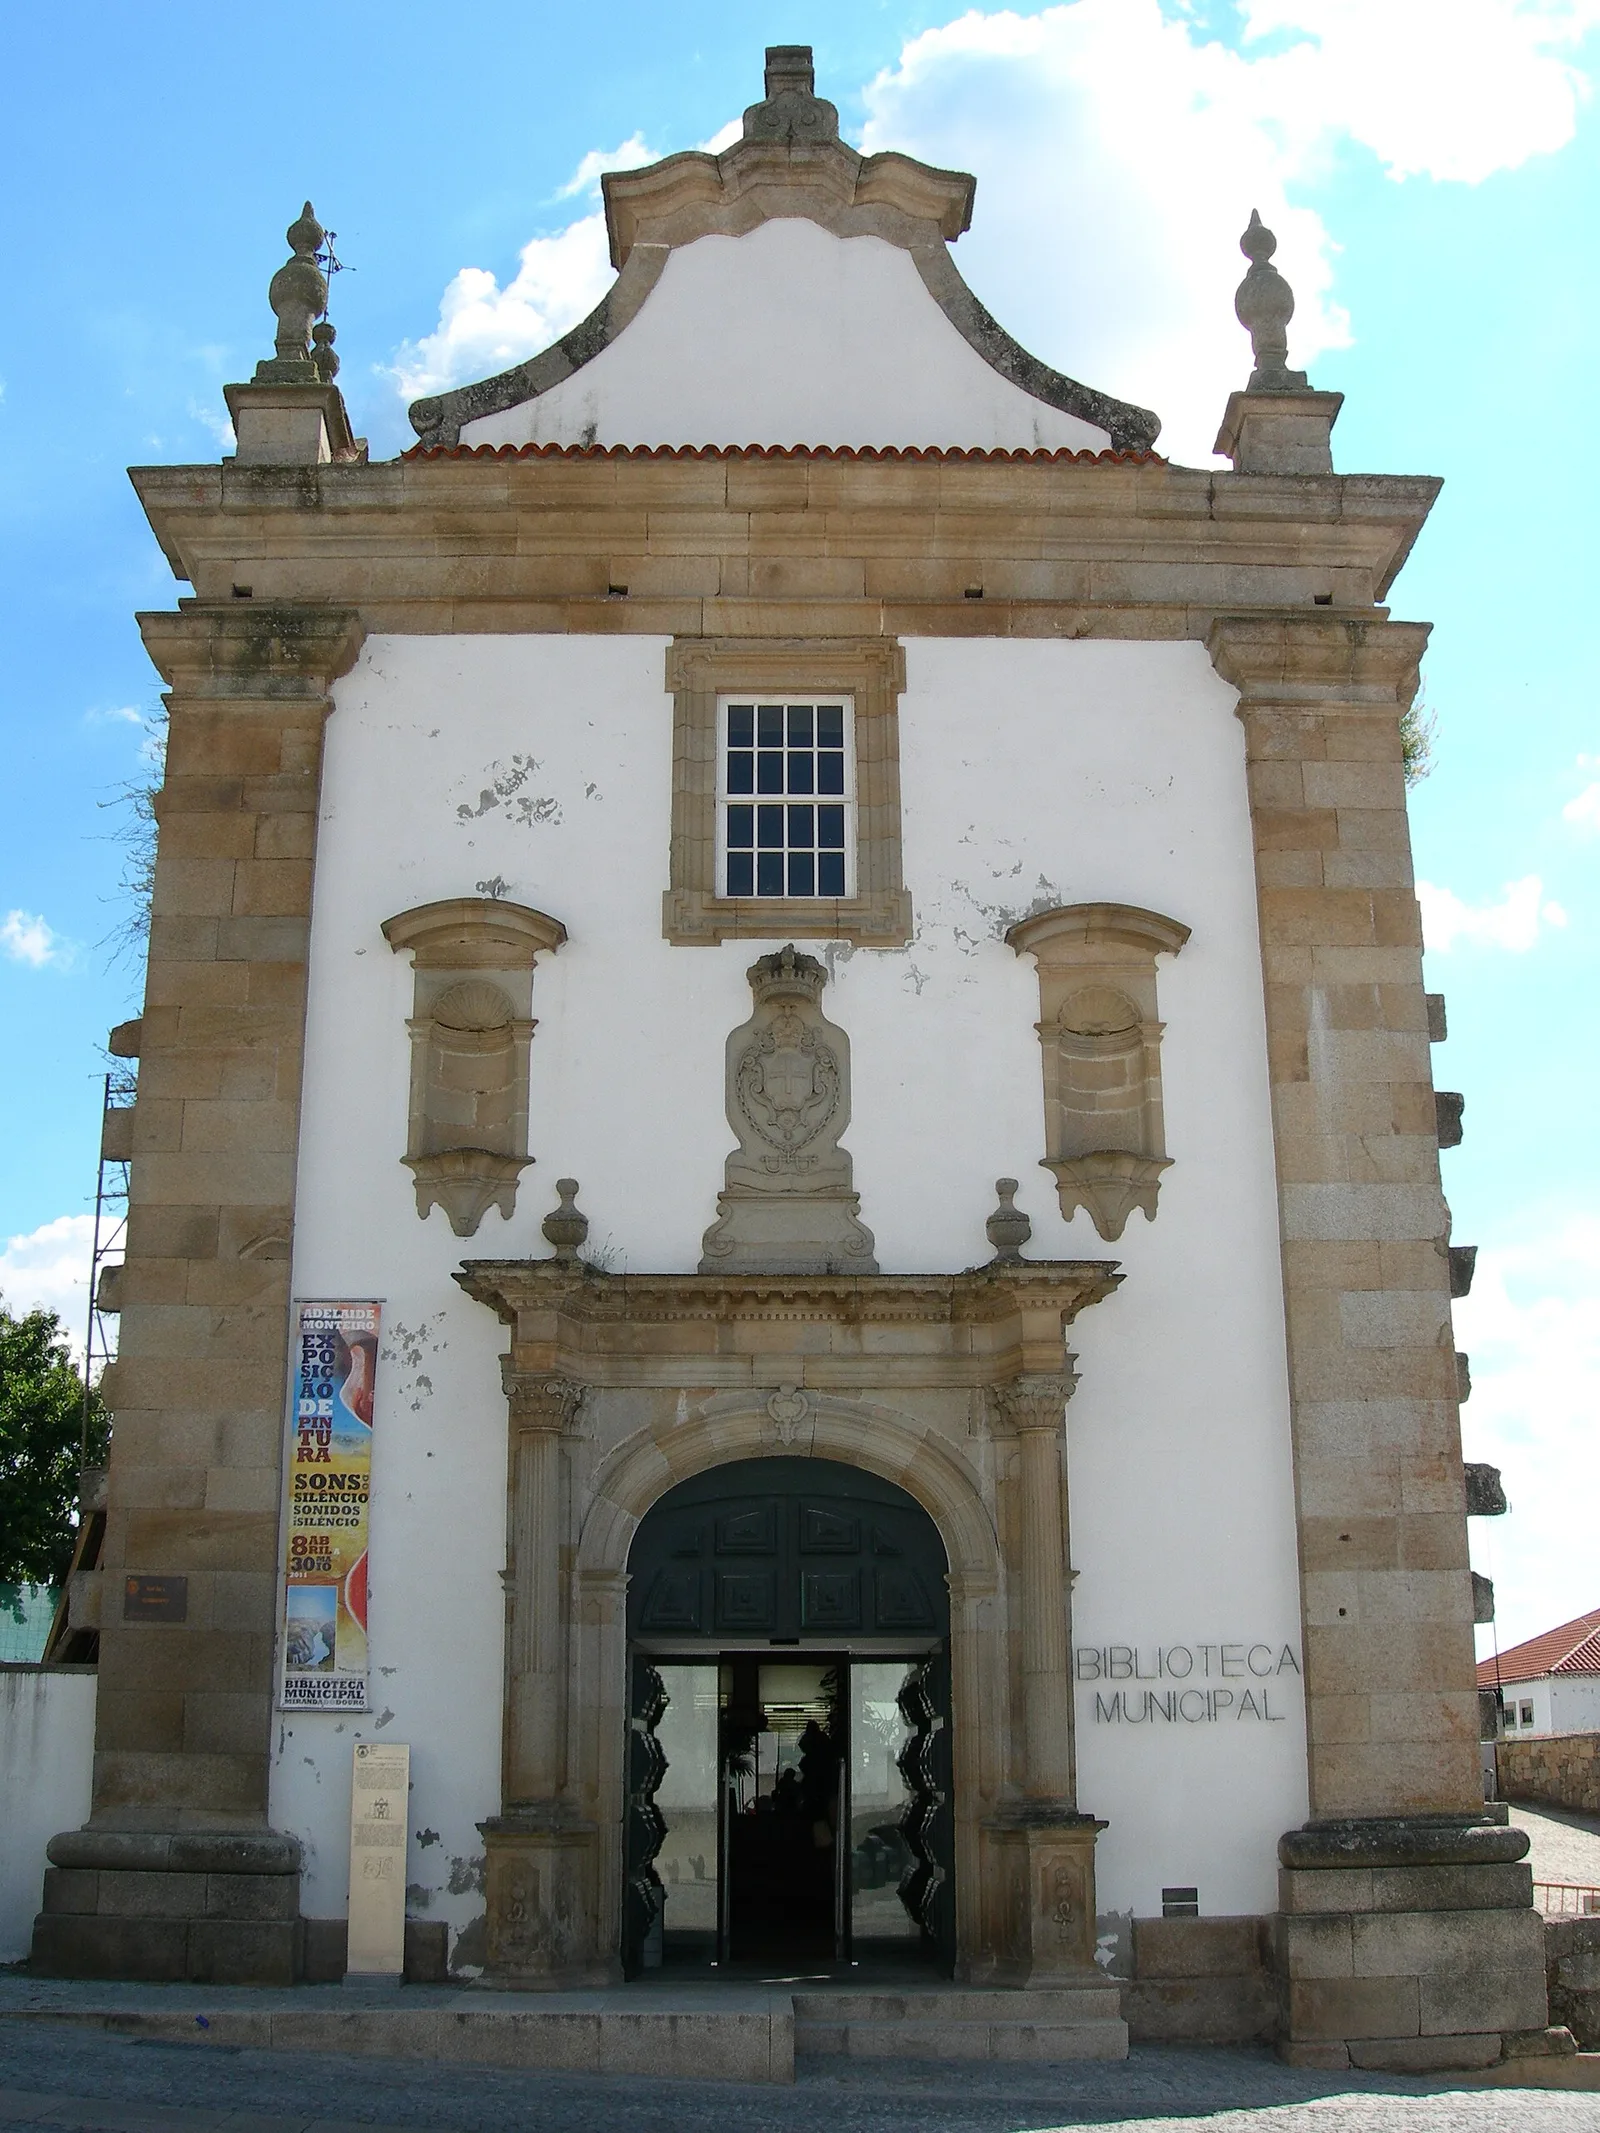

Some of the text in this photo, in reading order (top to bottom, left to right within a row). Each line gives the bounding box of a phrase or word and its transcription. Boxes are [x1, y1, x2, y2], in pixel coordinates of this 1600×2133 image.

[303, 1308, 375, 1319] ADELAIDE
[303, 1320, 375, 1330] MONTEIRO
[302, 1334, 336, 1349] EX
[302, 1349, 336, 1364] PO
[300, 1365, 334, 1383] SIÇ
[299, 1378, 334, 1399] ÃO
[298, 1400, 333, 1416] DE
[298, 1417, 332, 1429] PIN
[298, 1430, 332, 1446] TU
[296, 1447, 332, 1463] RA
[295, 1473, 361, 1490] SONS
[294, 1489, 369, 1504] SILÊNCIO
[293, 1505, 361, 1515] SONIDOS
[297, 1516, 359, 1527] SILÉNCIO
[291, 1535, 308, 1556] 8
[291, 1556, 316, 1572] 30
[1076, 1643, 1301, 1681] BIBLIOTECA
[285, 1680, 365, 1690] BIBLIOTECA
[284, 1689, 365, 1699] MUNICIPAL
[1095, 1688, 1286, 1723] MUNICIPAL
